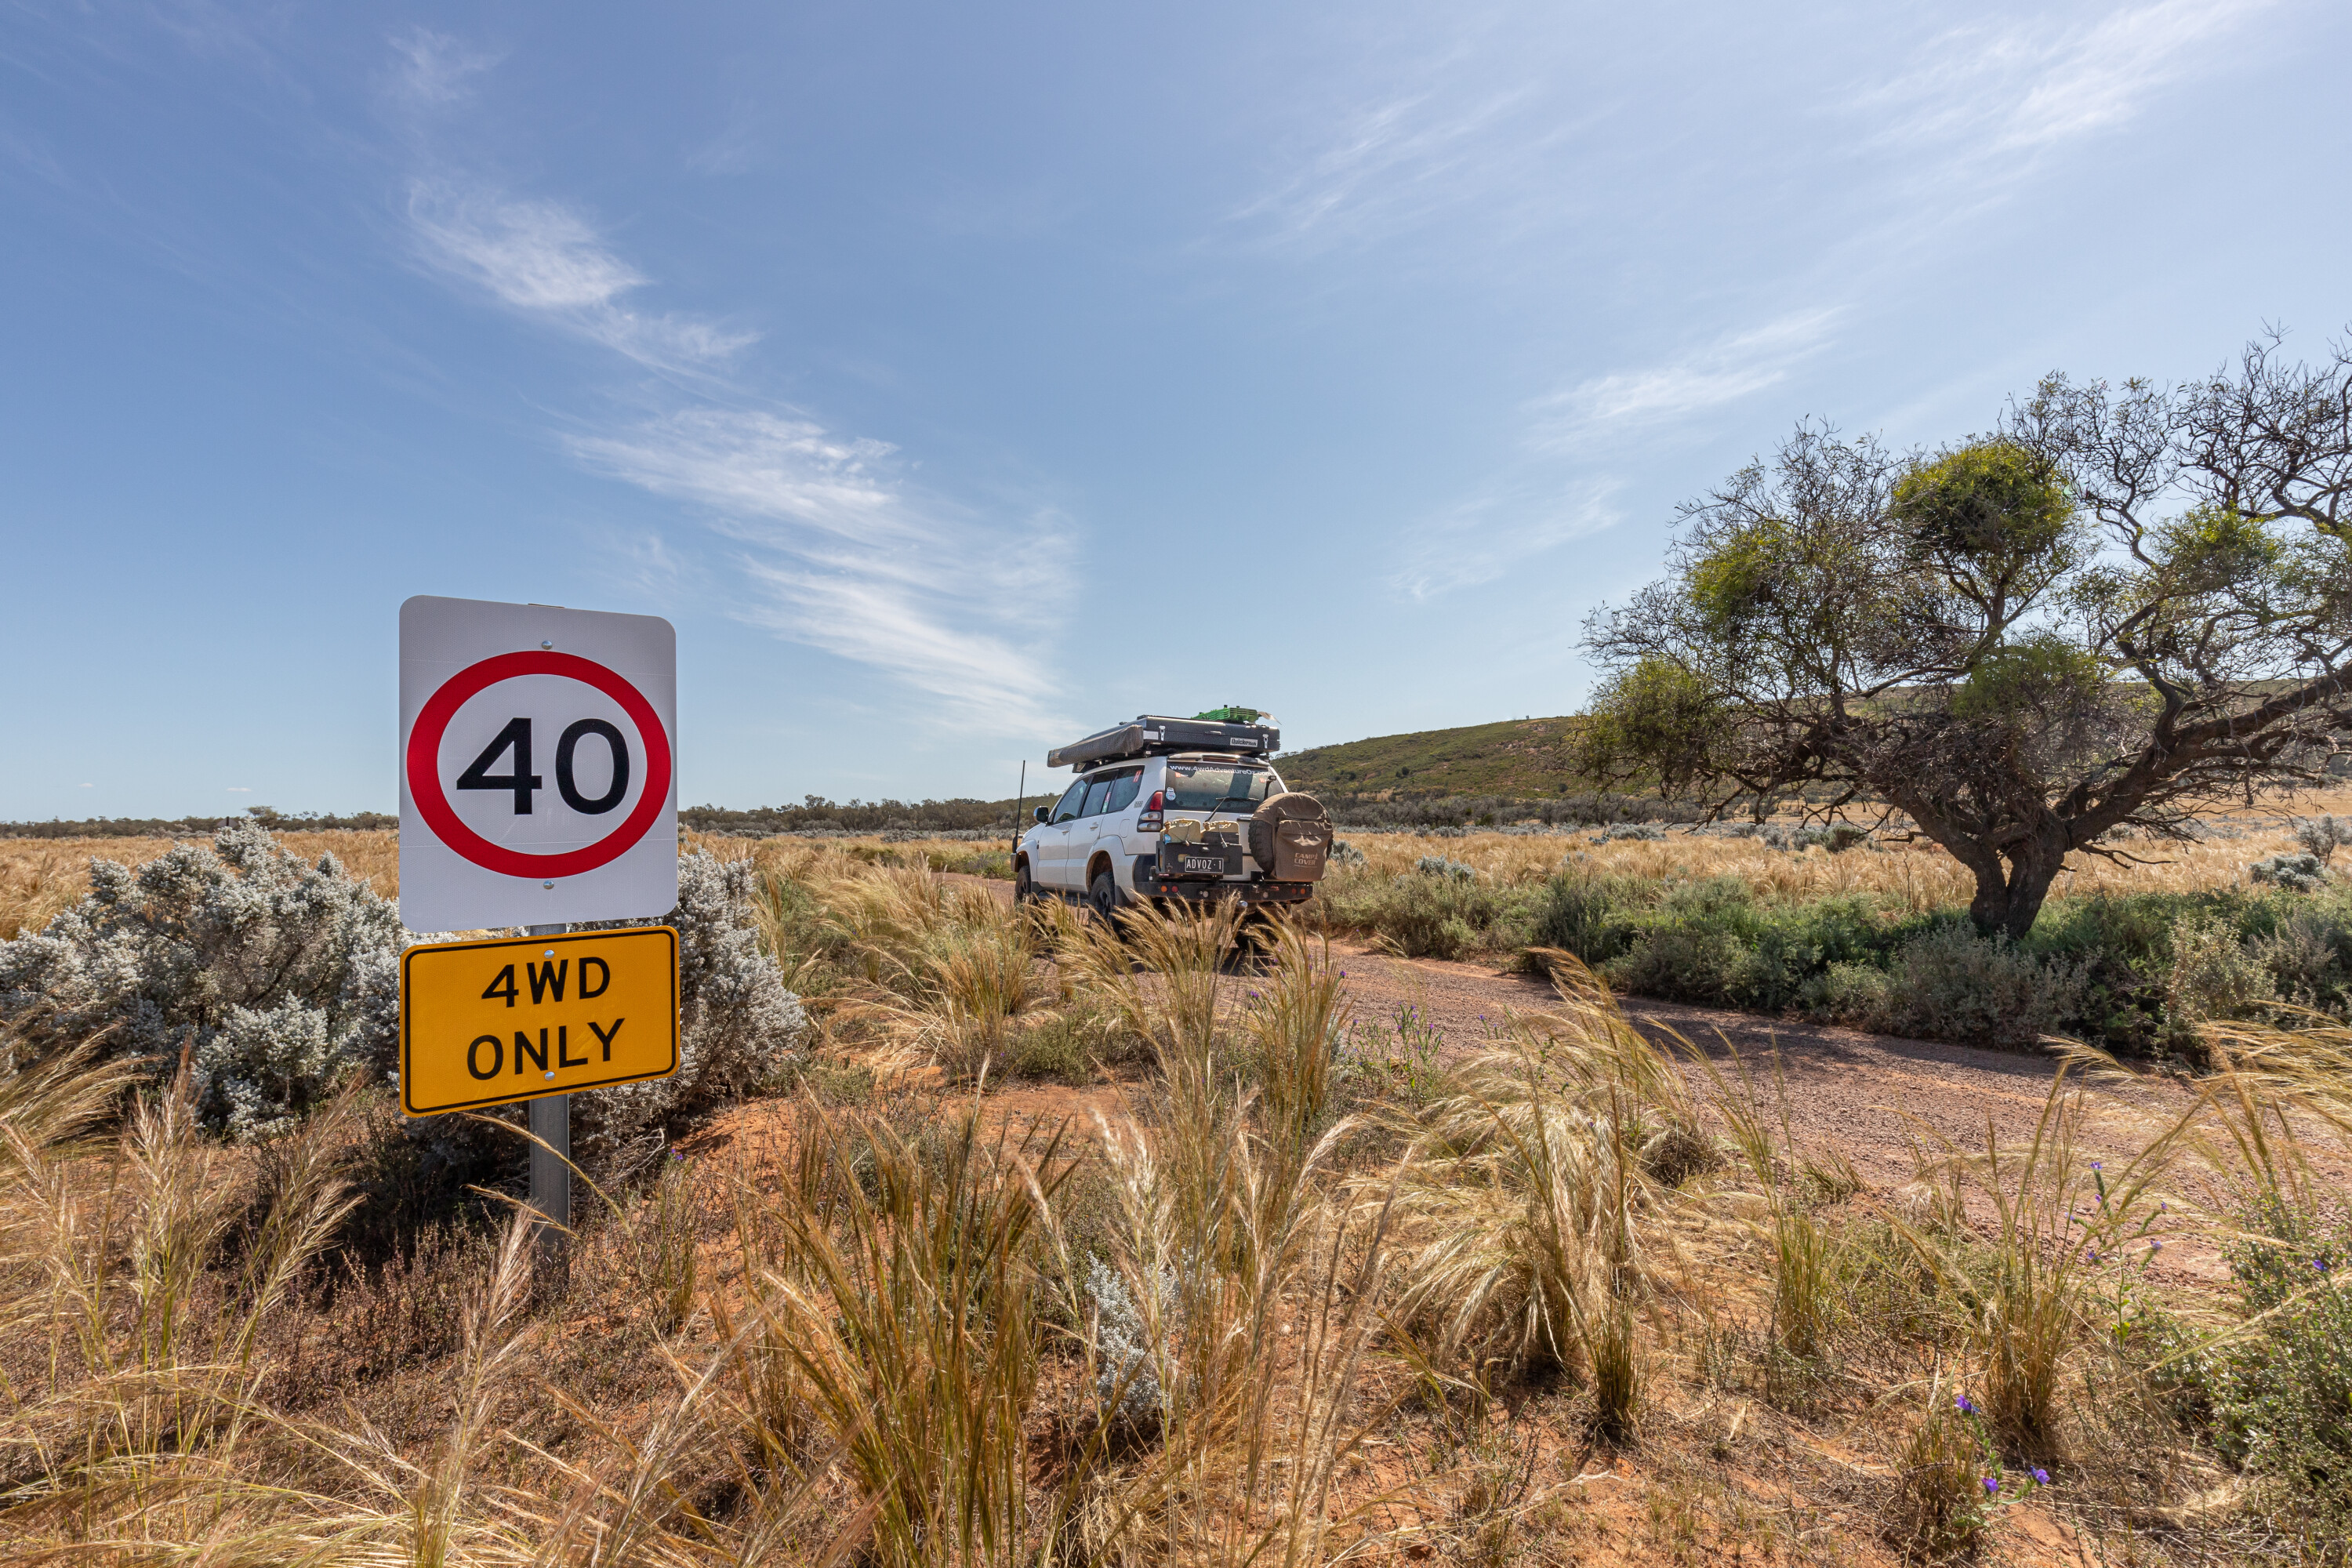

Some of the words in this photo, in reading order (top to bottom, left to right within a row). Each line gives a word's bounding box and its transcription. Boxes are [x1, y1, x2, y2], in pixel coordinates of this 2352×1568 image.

[456, 717, 630, 815] 40
[481, 956, 611, 1008] 4WD
[466, 1018, 625, 1080] ONLY
